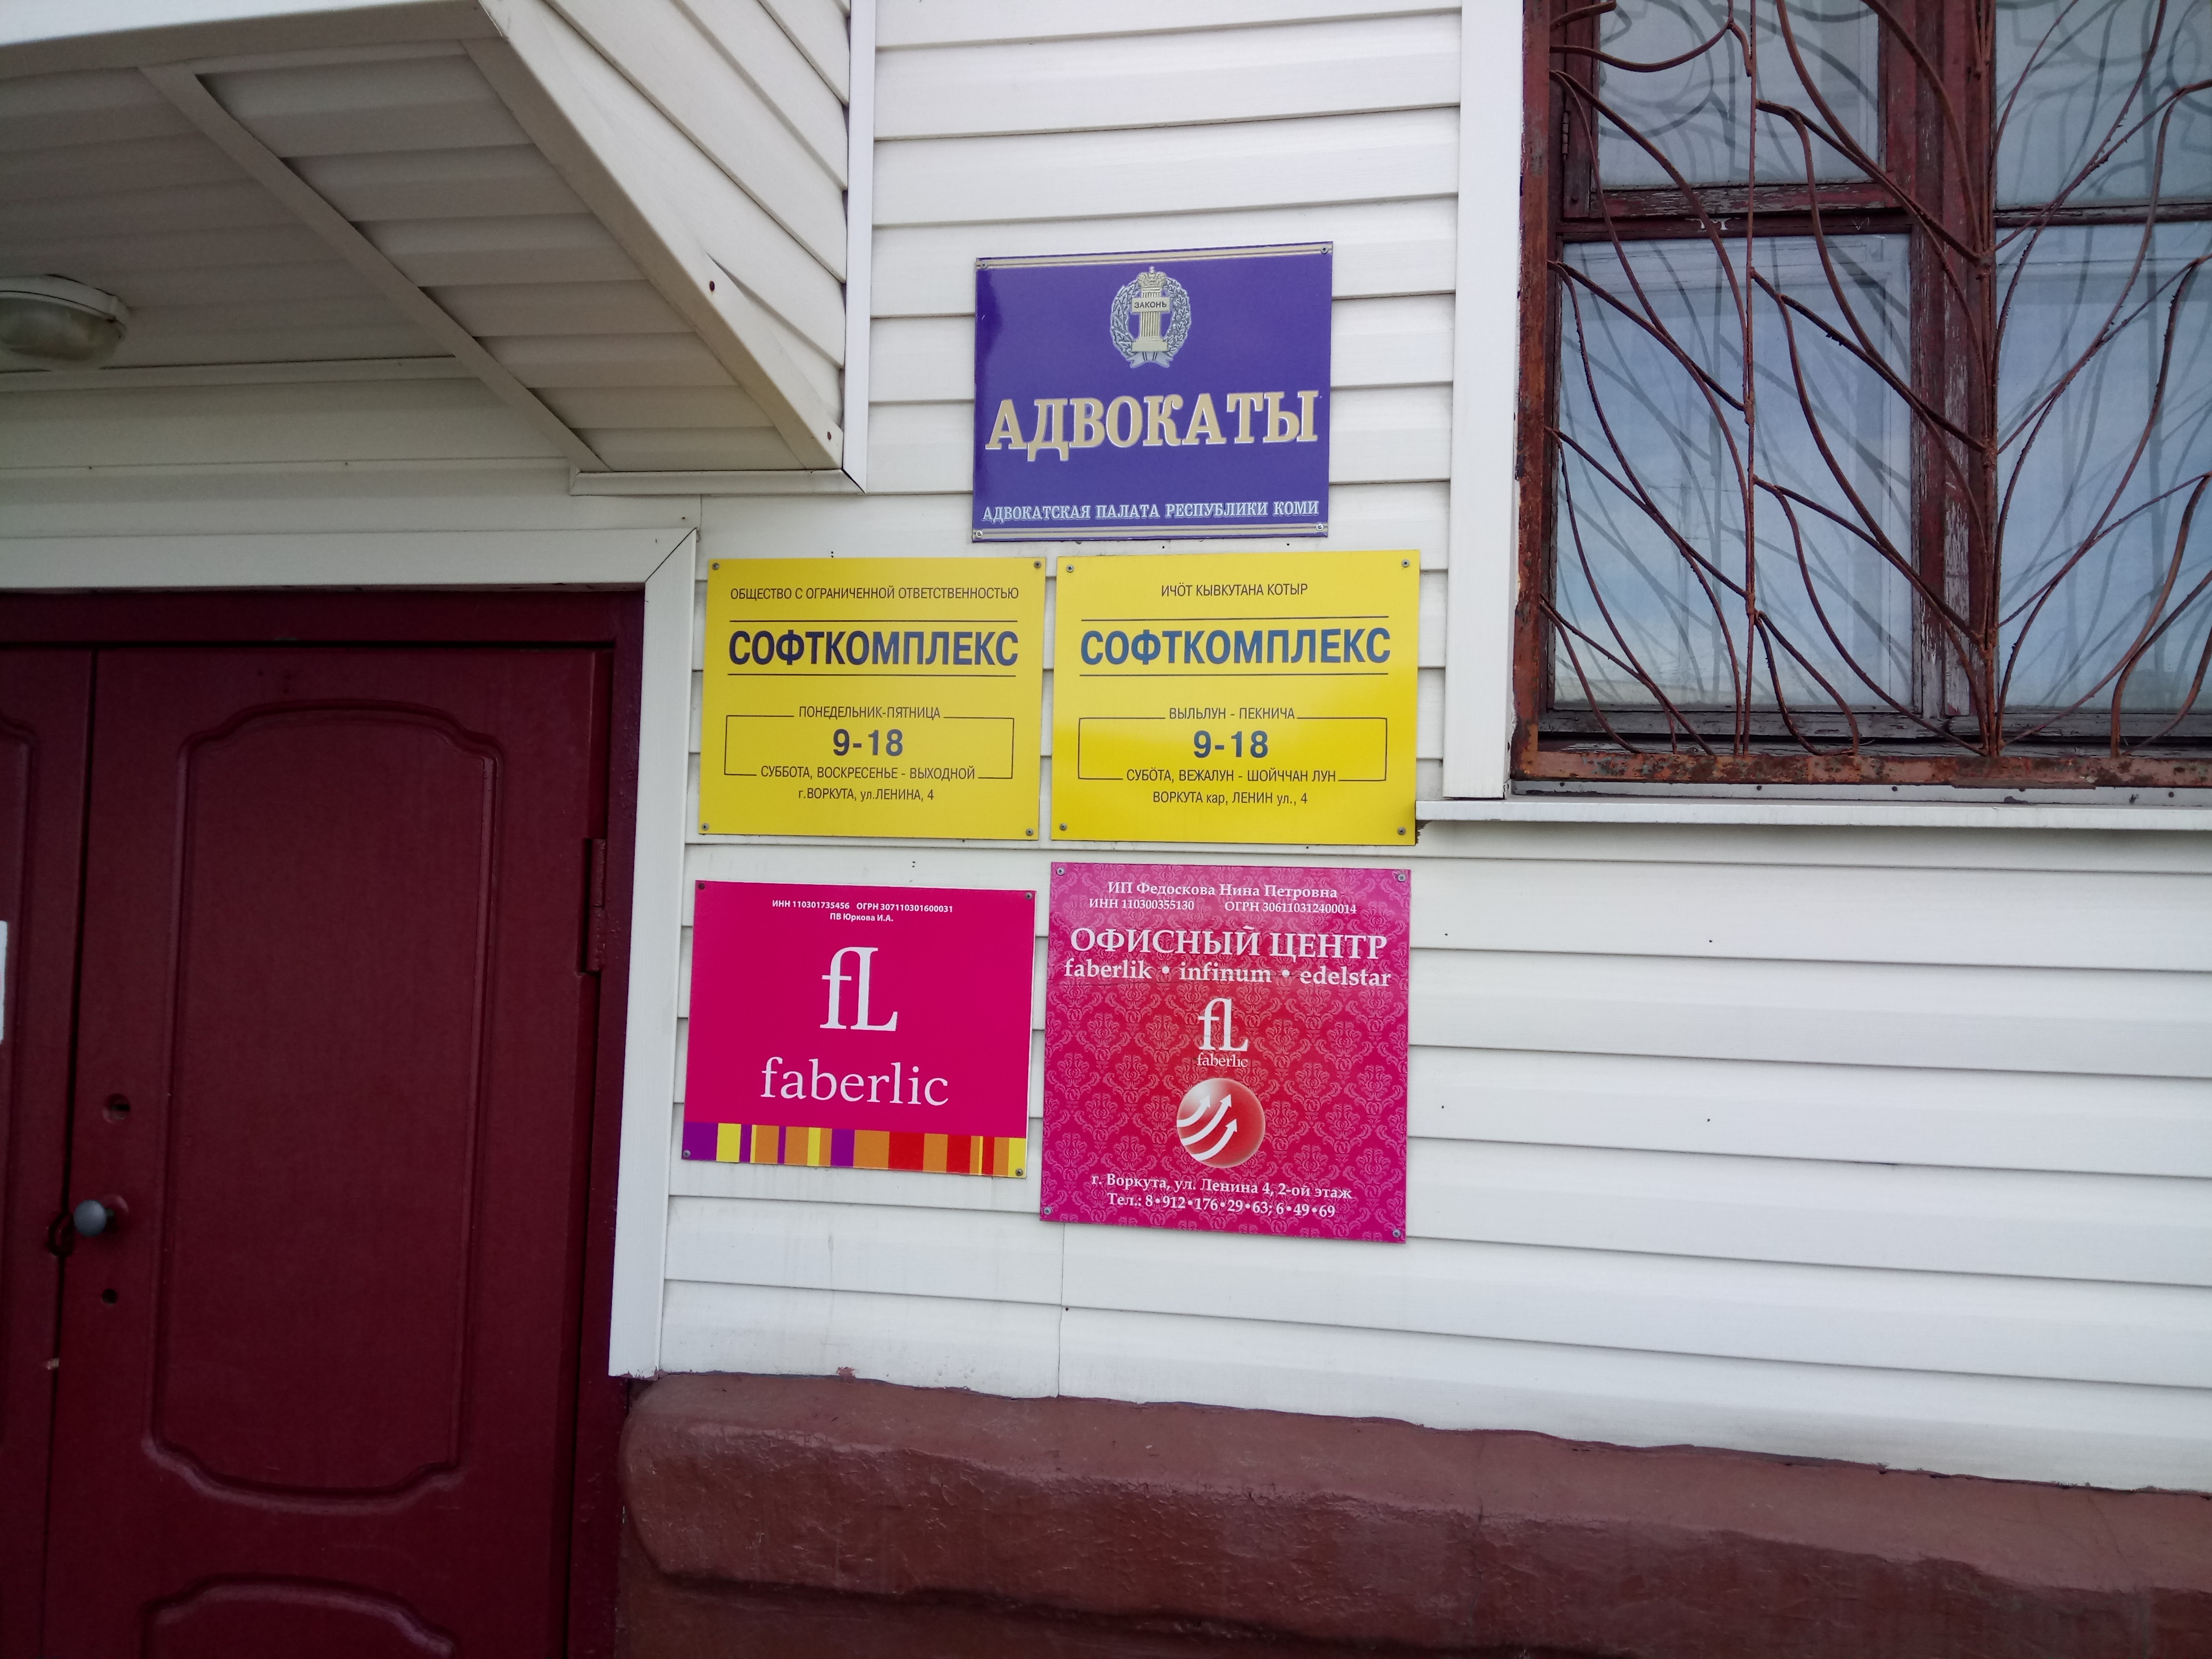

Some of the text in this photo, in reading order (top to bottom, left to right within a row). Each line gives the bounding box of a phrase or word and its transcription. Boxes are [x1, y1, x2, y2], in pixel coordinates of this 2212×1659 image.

[985, 390, 1320, 462] АДВОКАТЫ
[982, 500, 1319, 524] АДВОКАТСКАЯ ПАЛАТА РЕСПУБЛИКИ КОМИ
[731, 585, 1019, 601] ОБЩЕСТВО С ОГРАНИЧЕННОЙ ОТВЕТСТВЕННОСТЬЮ
[1196, 583, 1264, 596] КЫВКУТАНА
[1268, 583, 1308, 596] КОТЫР
[728, 629, 1019, 666] СОФТКОМПЛЕКС
[1080, 627, 1390, 666] СОФТКОМПЛЕКС
[799, 706, 941, 720] ПОНЕДЕЛЬНИК-ПЯТНИЦА
[1169, 707, 1226, 719] ВЫЛЬЛУН
[1239, 708, 1295, 719] ПЕКНИЧА
[833, 728, 904, 756] 9-18
[1193, 730, 1269, 758] 9-18
[760, 766, 813, 781] СУББОТА,
[817, 767, 898, 779] ВОСКРЕСЕНЬЕ
[910, 765, 975, 781] ВЫХОДНОЙ
[1179, 769, 1234, 782] ВЕЖАЛУН
[1247, 767, 1308, 782] ШОЙЧЧАН
[1312, 770, 1336, 782] ЛУН
[799, 787, 934, 802] г.ВОРКУТА, ул.ЛЕНИНА, 4
[1153, 791, 1308, 806] ВОРКУТА кар, ЛЕНИН ул., 4
[1108, 882, 1338, 901] ИП Федоскова Нина Петровна
[793, 901, 850, 909] 110301735456
[880, 903, 953, 912] 307110301600031
[1089, 898, 1357, 914] ИНН 110300355130 ОГРН 306110312400014
[843, 913, 875, 922] Юркова
[1070, 925, 1387, 962] ОФИСНЫЙ ЦЕНТР
[1064, 958, 1391, 987] faberlik infinum edelstar
[1196, 1053, 1249, 1068] faberlic
[760, 1057, 949, 1107] faberlic
[1091, 1173, 1352, 1199] г. Воркута, ул. Ленина 4, 2-ой этаж
[1107, 1193, 1142, 1206] Тел.:
